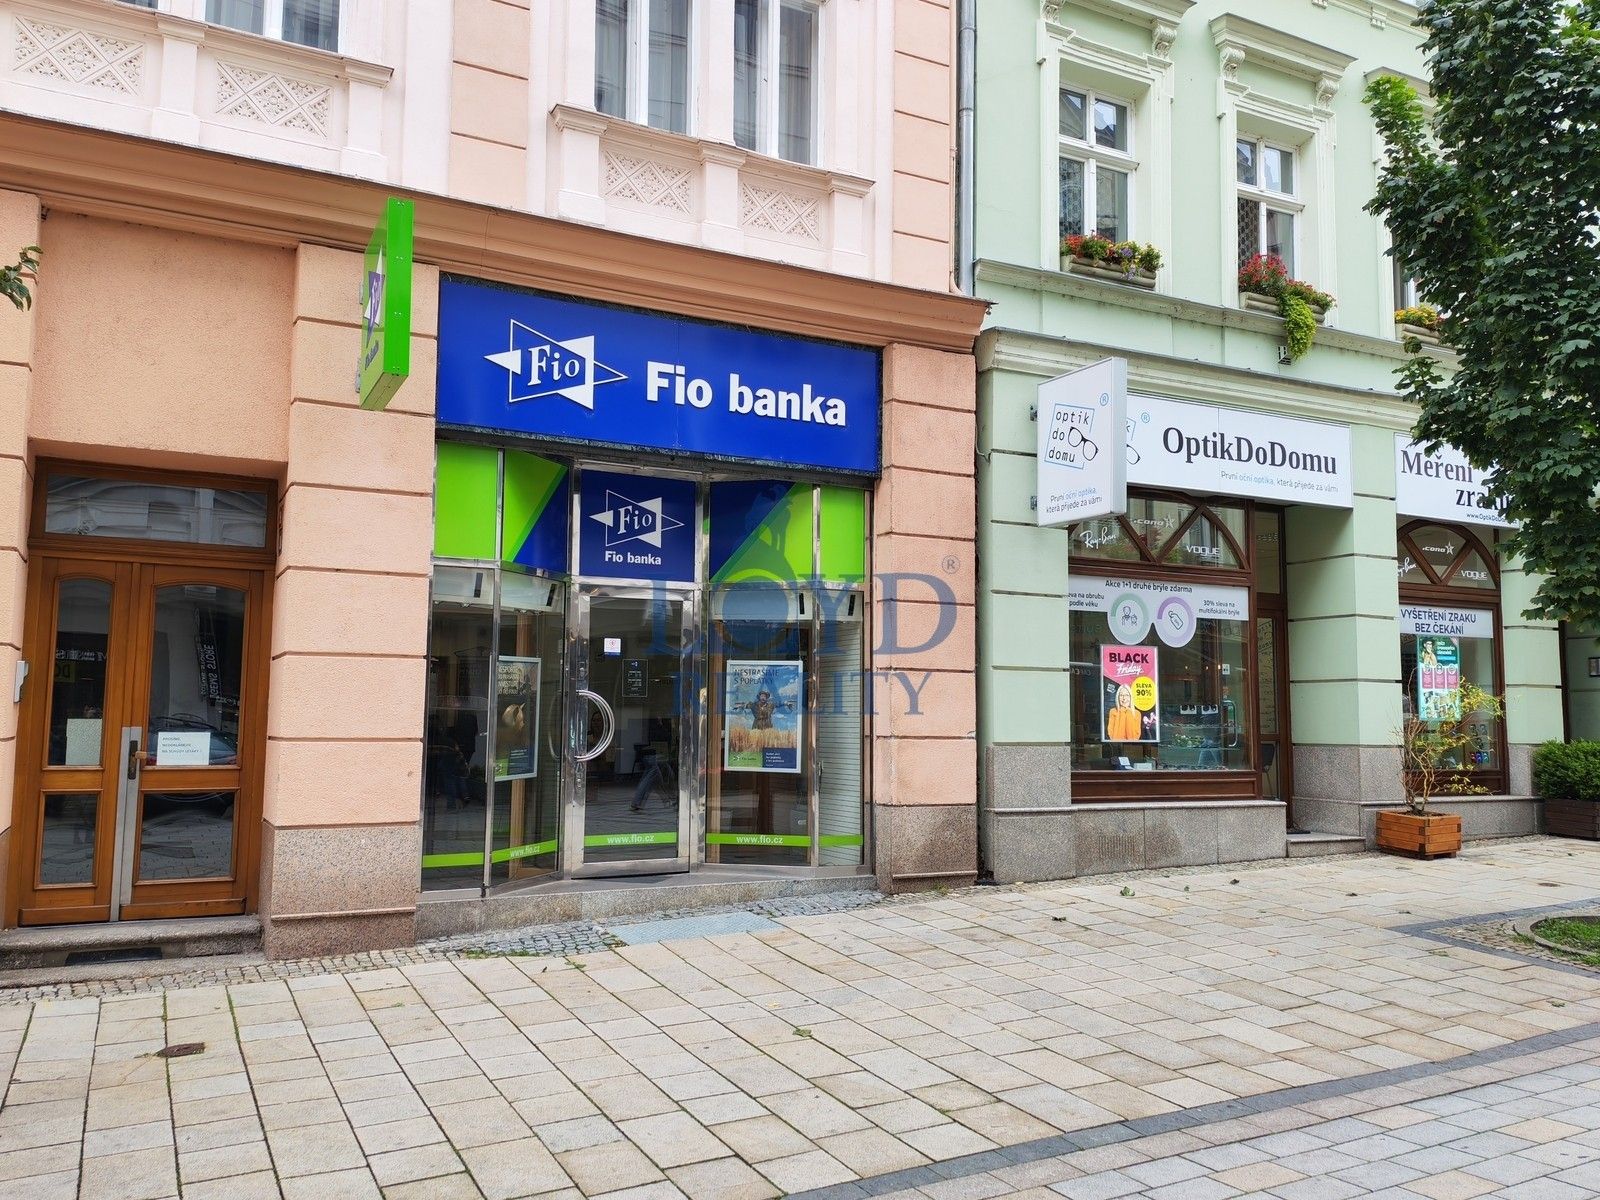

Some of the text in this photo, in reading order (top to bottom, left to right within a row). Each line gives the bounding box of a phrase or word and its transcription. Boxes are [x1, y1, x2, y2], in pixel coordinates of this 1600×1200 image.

[527, 344, 581, 387] Fio
[646, 360, 846, 426] Fio banka
[1055, 410, 1090, 426] optik
[1052, 428, 1065, 441] do
[1048, 447, 1076, 463] domu
[1162, 426, 1338, 475] OptikDoDomu
[617, 505, 652, 535] Fio
[605, 550, 662, 565] Fio banka
[1105, 580, 1120, 588] Akce
[1132, 581, 1152, 590] druhé
[1152, 583, 1168, 592] brýle
[1170, 585, 1193, 593] zdarma
[1400, 607, 1477, 623] VYŠETŘENÍ ZRAKU
[1415, 621, 1464, 635] BEZ ČEKÁNÍ
[1109, 652, 1149, 664] BLACK
[1115, 661, 1145, 675] Friday
[1136, 689, 1152, 697] 90%
[607, 834, 655, 845] www.fio.cz
[736, 834, 784, 845] www.fio.cz
